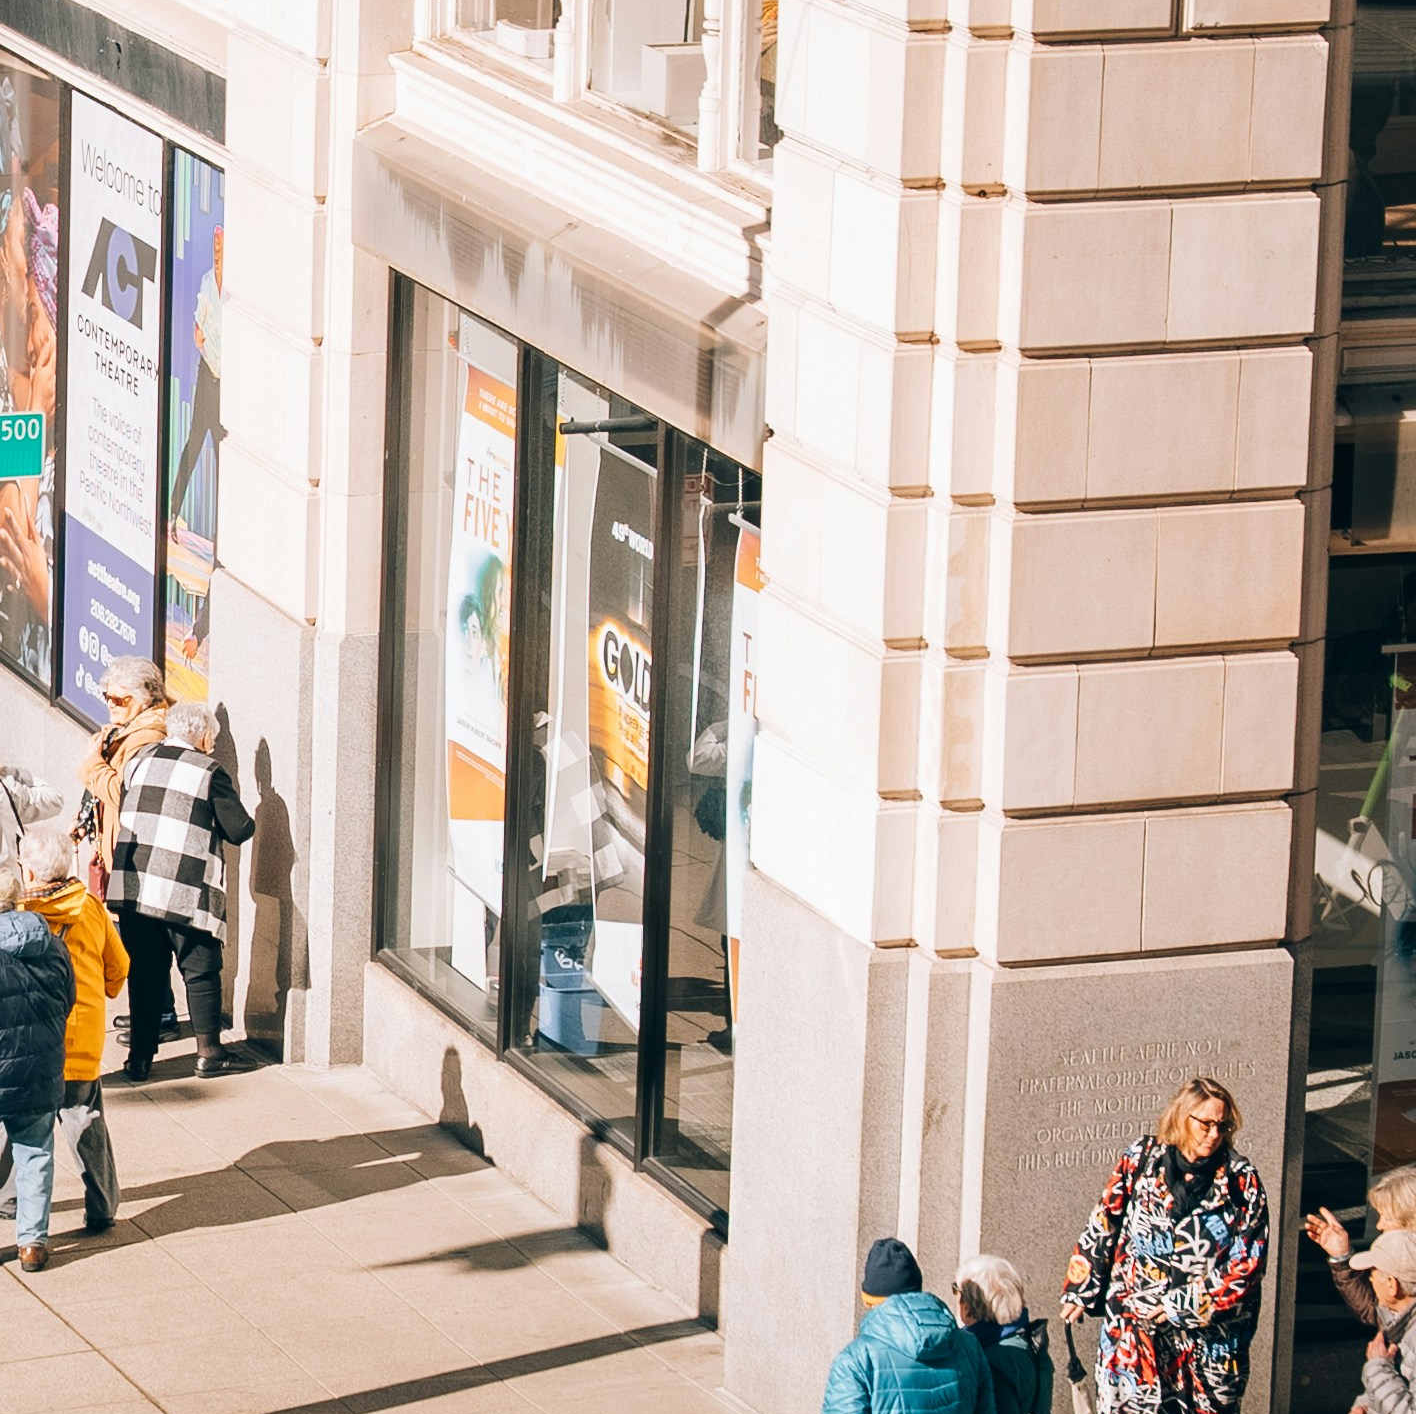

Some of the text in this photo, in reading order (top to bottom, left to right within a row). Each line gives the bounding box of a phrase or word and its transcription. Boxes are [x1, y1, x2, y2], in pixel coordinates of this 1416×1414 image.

[81, 139, 162, 216] Welcome to
[77, 314, 159, 381] CONTEMPORARY
[95, 351, 139, 396] THEATRE
[93, 397, 141, 447] The voice of
[88, 425, 145, 482] contemporary
[90, 448, 143, 503] theatre in the
[80, 470, 107, 505] Pacific
[109, 490, 152, 538] Northwest
[468, 457, 501, 503] THE
[464, 492, 500, 548] FIVE
[1059, 1046, 1127, 1066] SEATTLE
[1135, 1041, 1179, 1061] AERIE
[1018, 1061, 1257, 1095] FRATERNAL ORDER OF EAGLES
[1093, 1094, 1161, 1115] MOTHER
[1037, 1122, 1133, 1145] ORGANIZED
[1017, 1154, 1050, 1171] THIS
